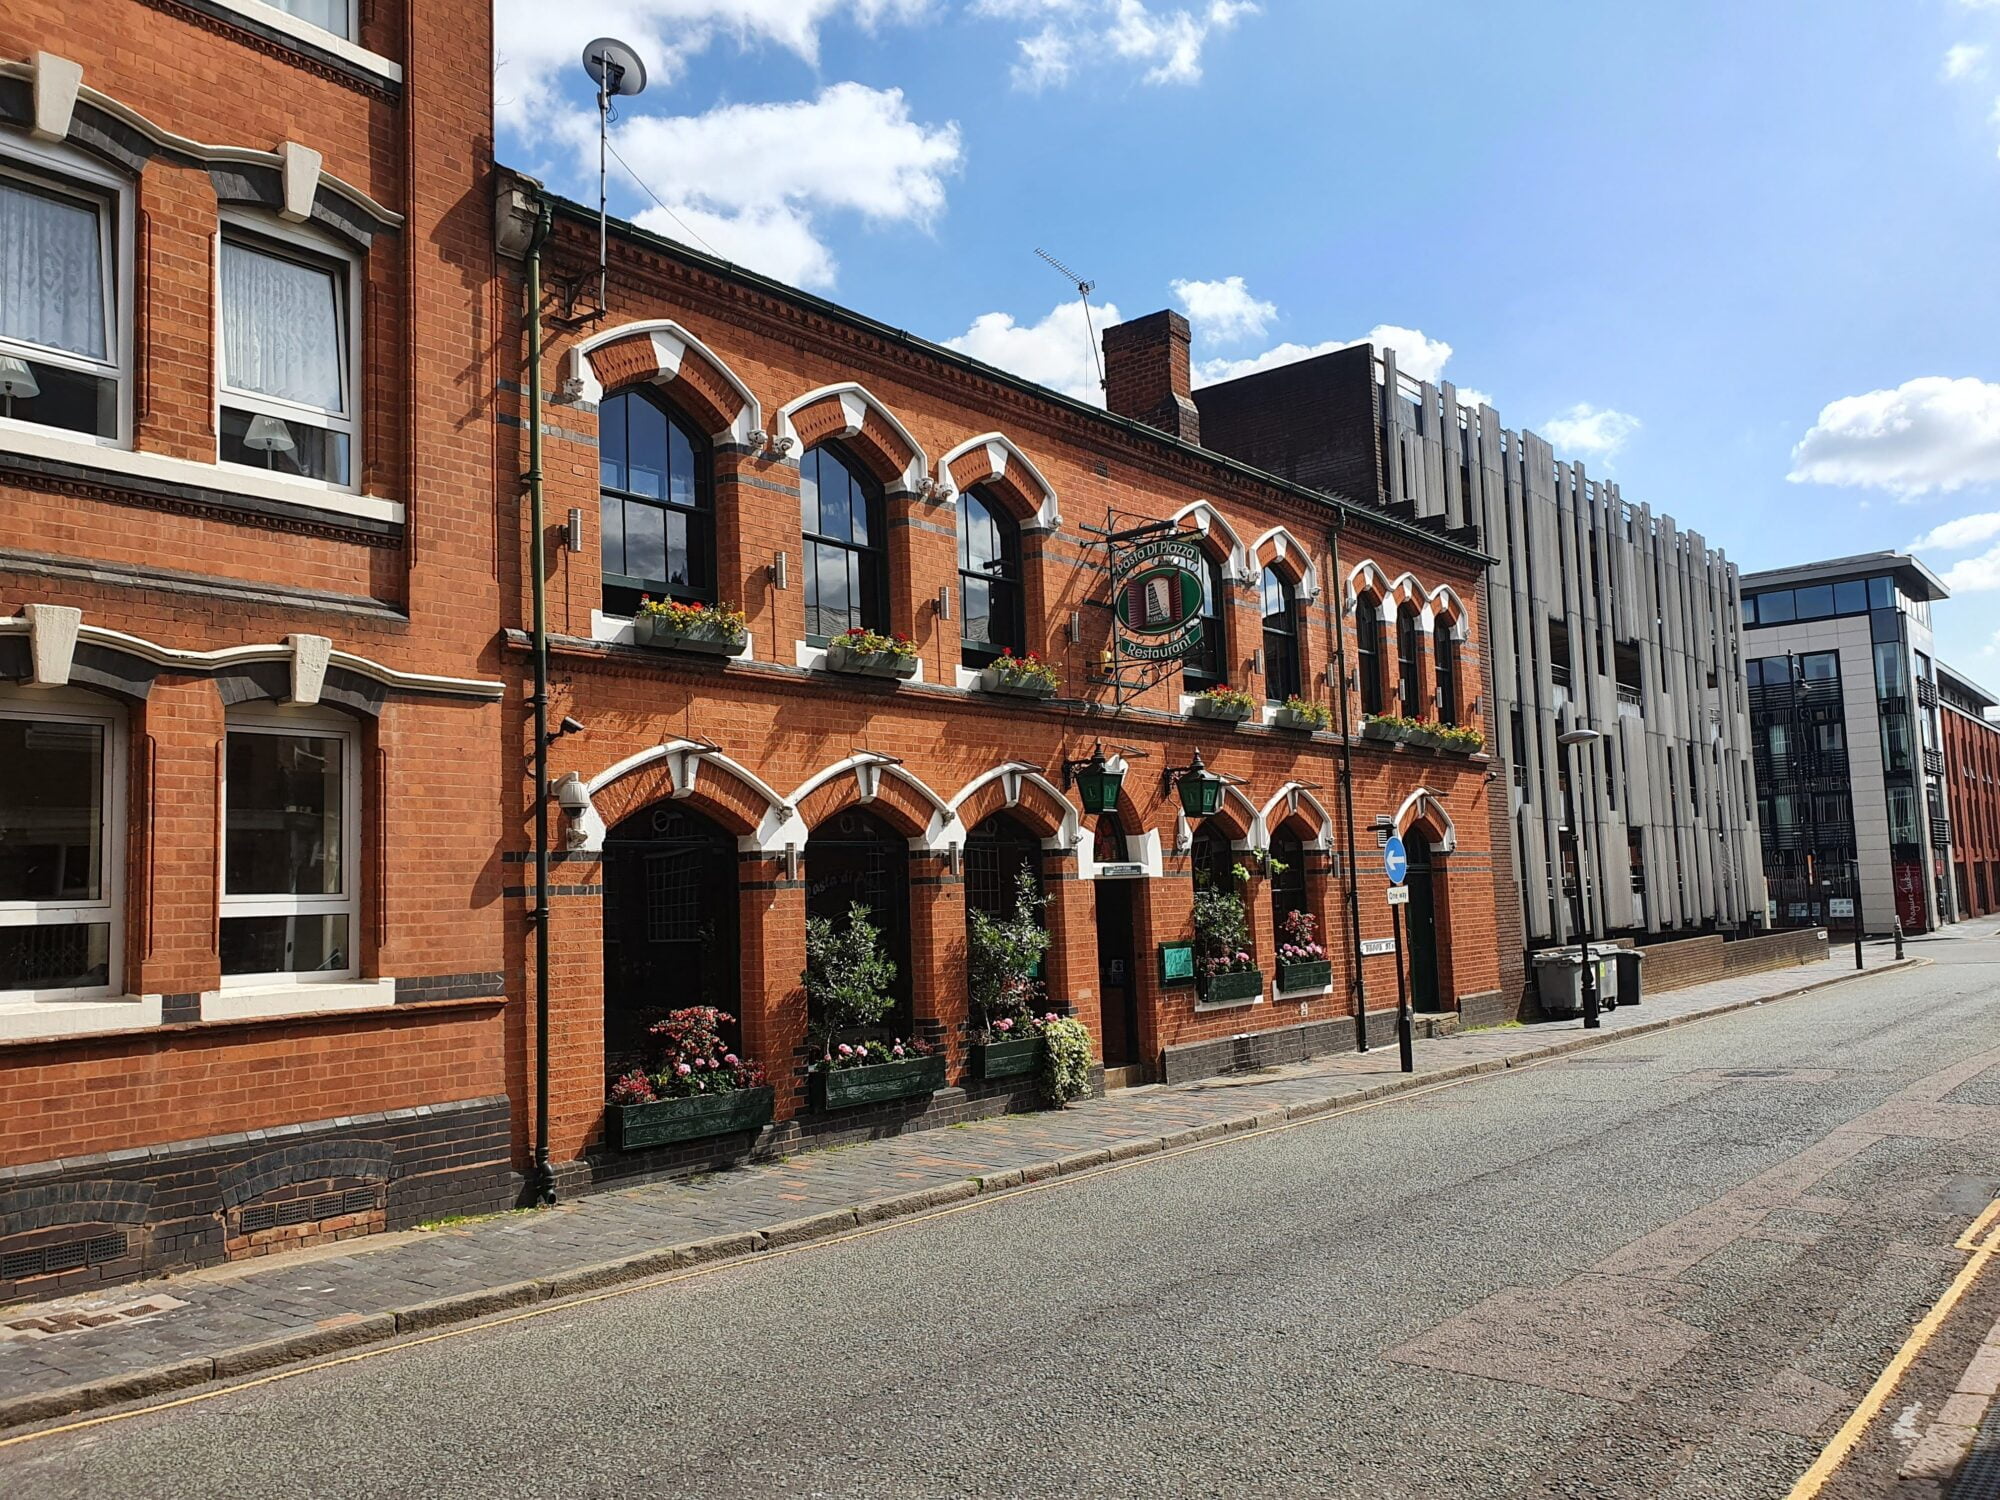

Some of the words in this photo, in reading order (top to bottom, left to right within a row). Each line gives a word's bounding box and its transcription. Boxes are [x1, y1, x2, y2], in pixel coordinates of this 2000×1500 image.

[1117, 551, 1145, 574] Pasta
[1160, 541, 1195, 558] Piazza
[1127, 635, 1192, 660] Restaurant
